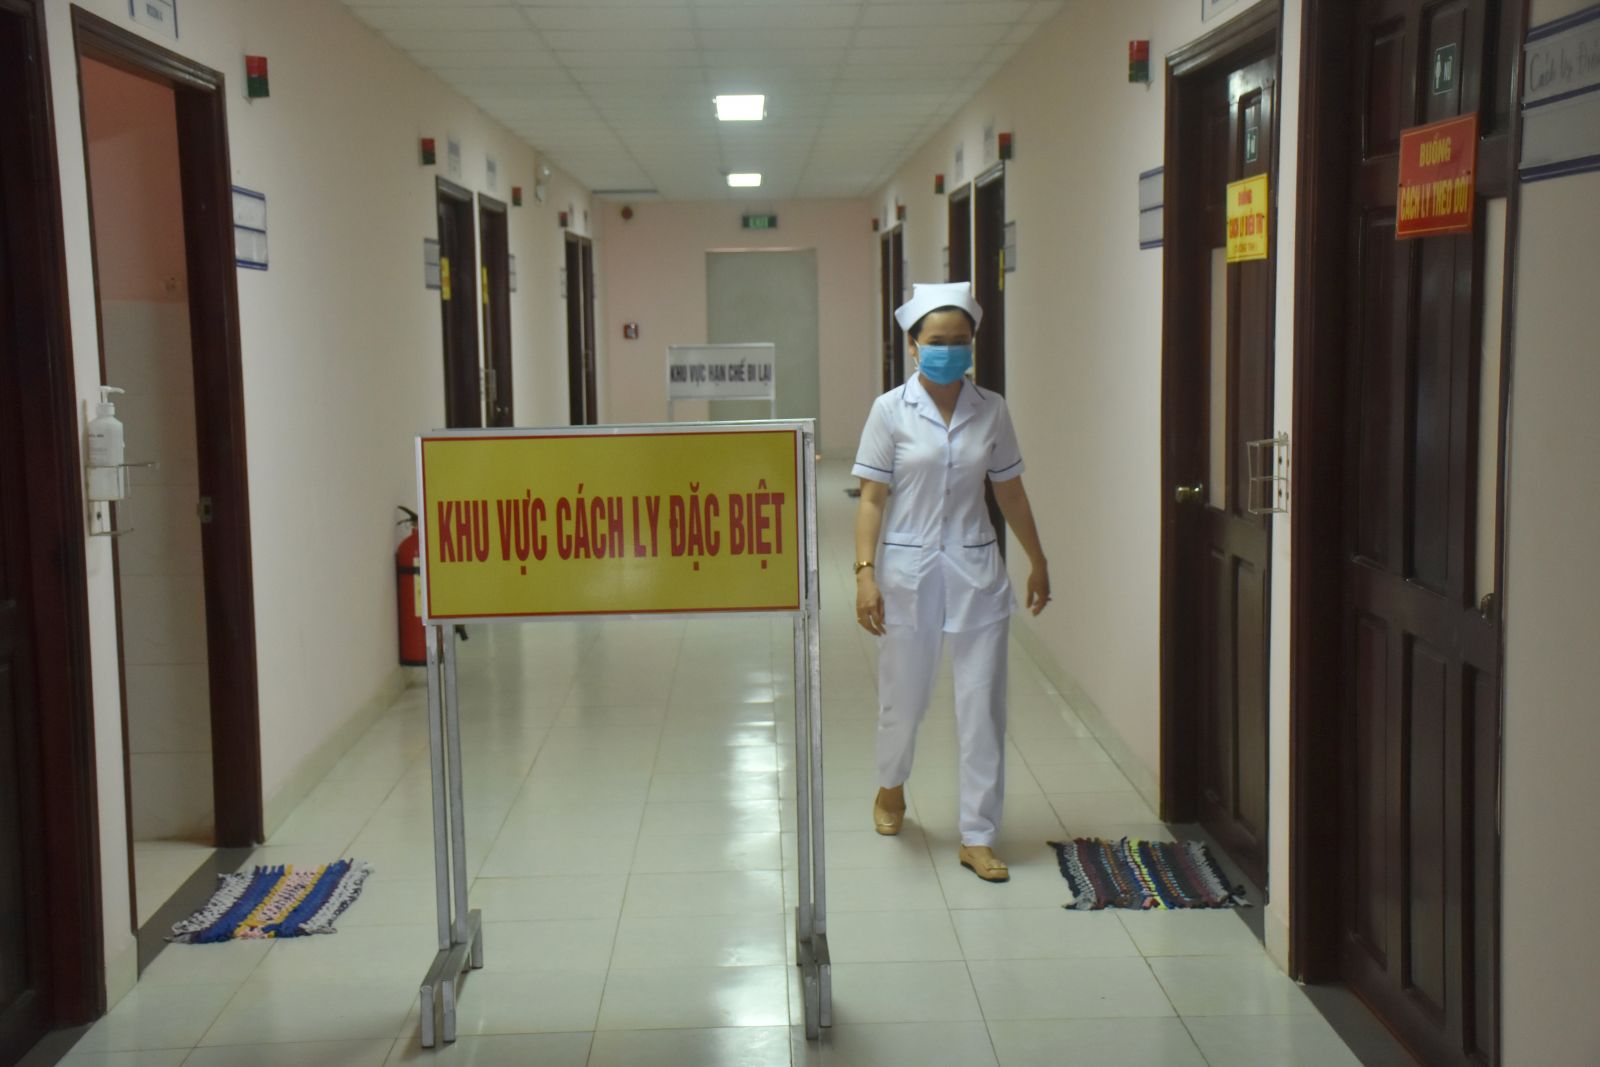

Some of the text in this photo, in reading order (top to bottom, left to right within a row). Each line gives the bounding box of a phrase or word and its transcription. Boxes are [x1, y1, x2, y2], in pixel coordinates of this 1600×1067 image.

[437, 478, 785, 576] KHU VỰC CÁCH LY ĐẶC BIỆT
